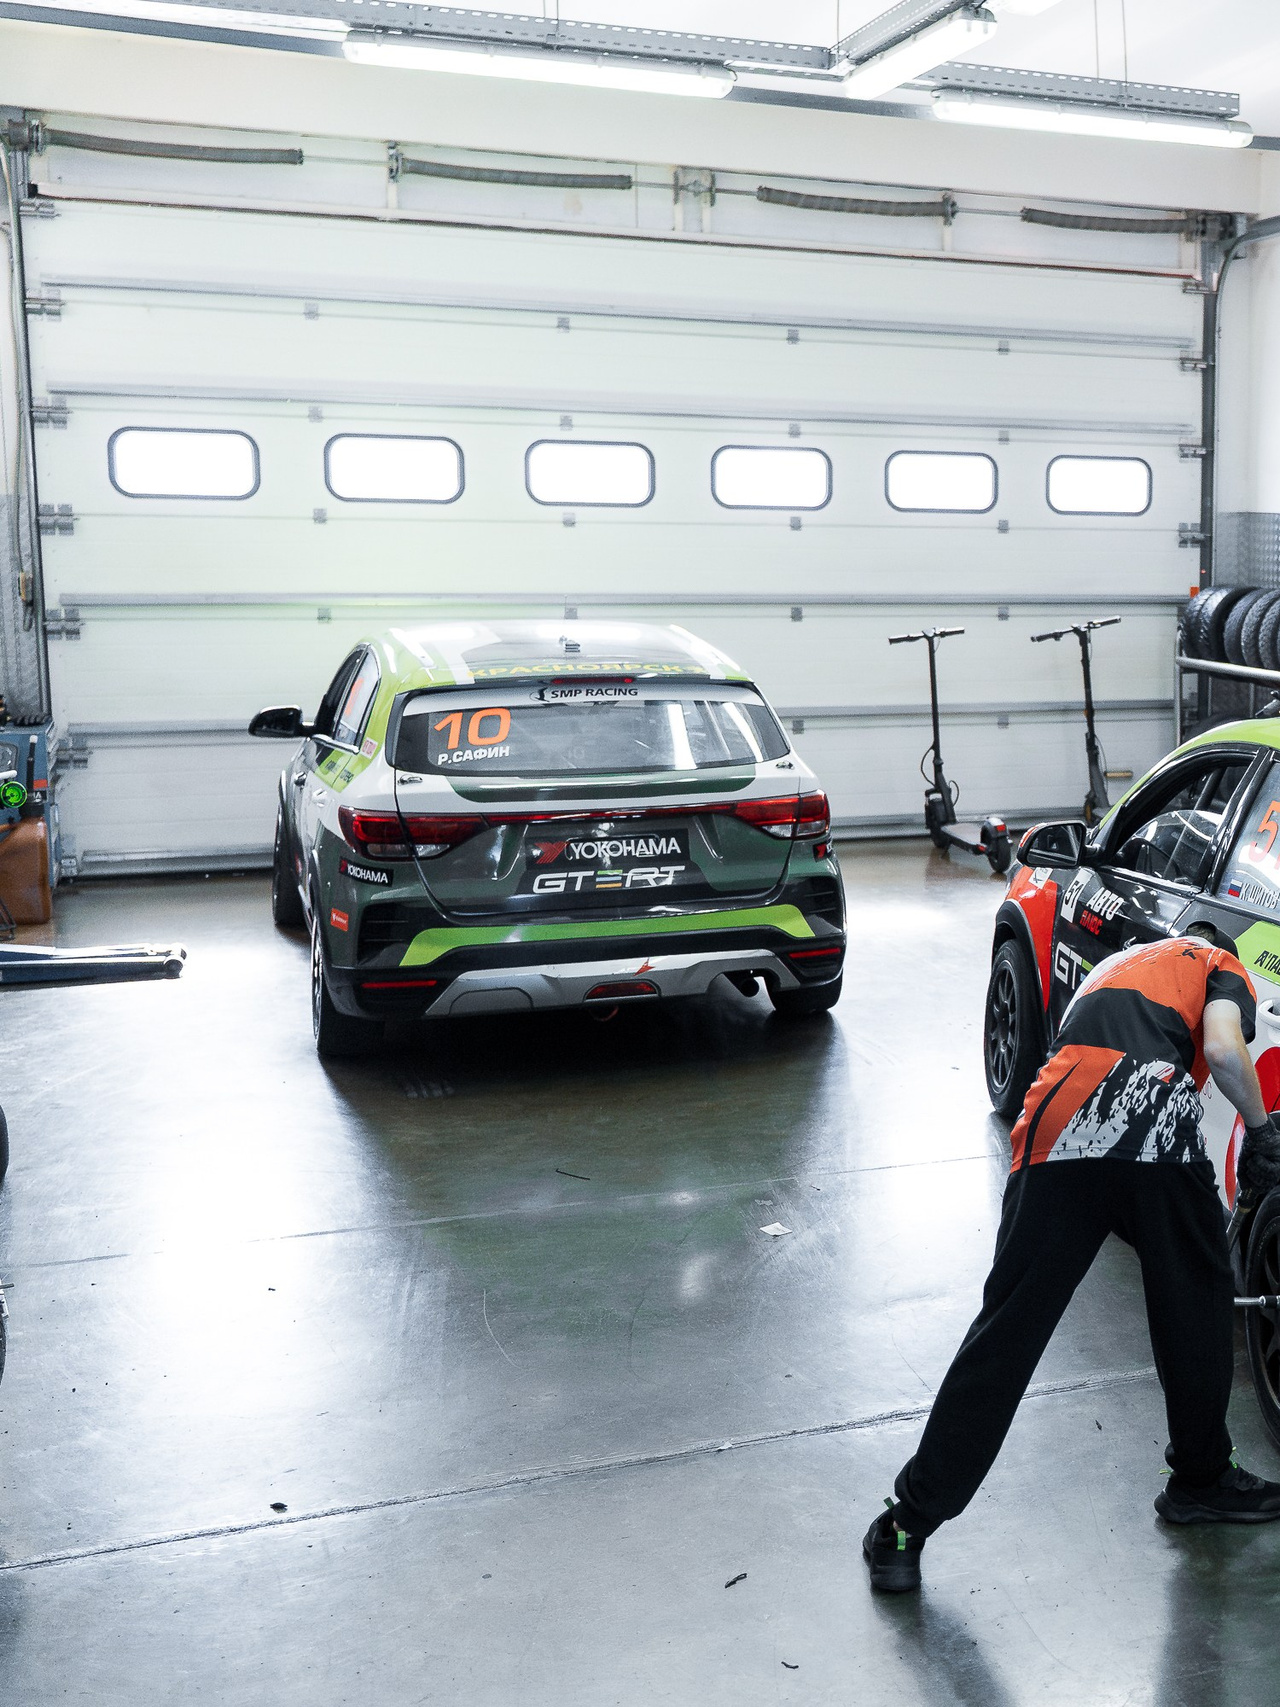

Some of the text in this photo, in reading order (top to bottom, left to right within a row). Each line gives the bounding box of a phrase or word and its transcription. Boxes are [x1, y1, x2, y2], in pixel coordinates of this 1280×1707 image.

[551, 687, 638, 699] SMP RACING
[433, 707, 511, 750] 10
[437, 746, 510, 766] Р.САФИН
[571, 837, 682, 860] YOKOHAMA
[347, 863, 389, 884] YOKOHAMA
[1064, 880, 1085, 909] 51
[1086, 886, 1125, 921] АВТО
[1240, 883, 1280, 909] К.ШИТОВ
